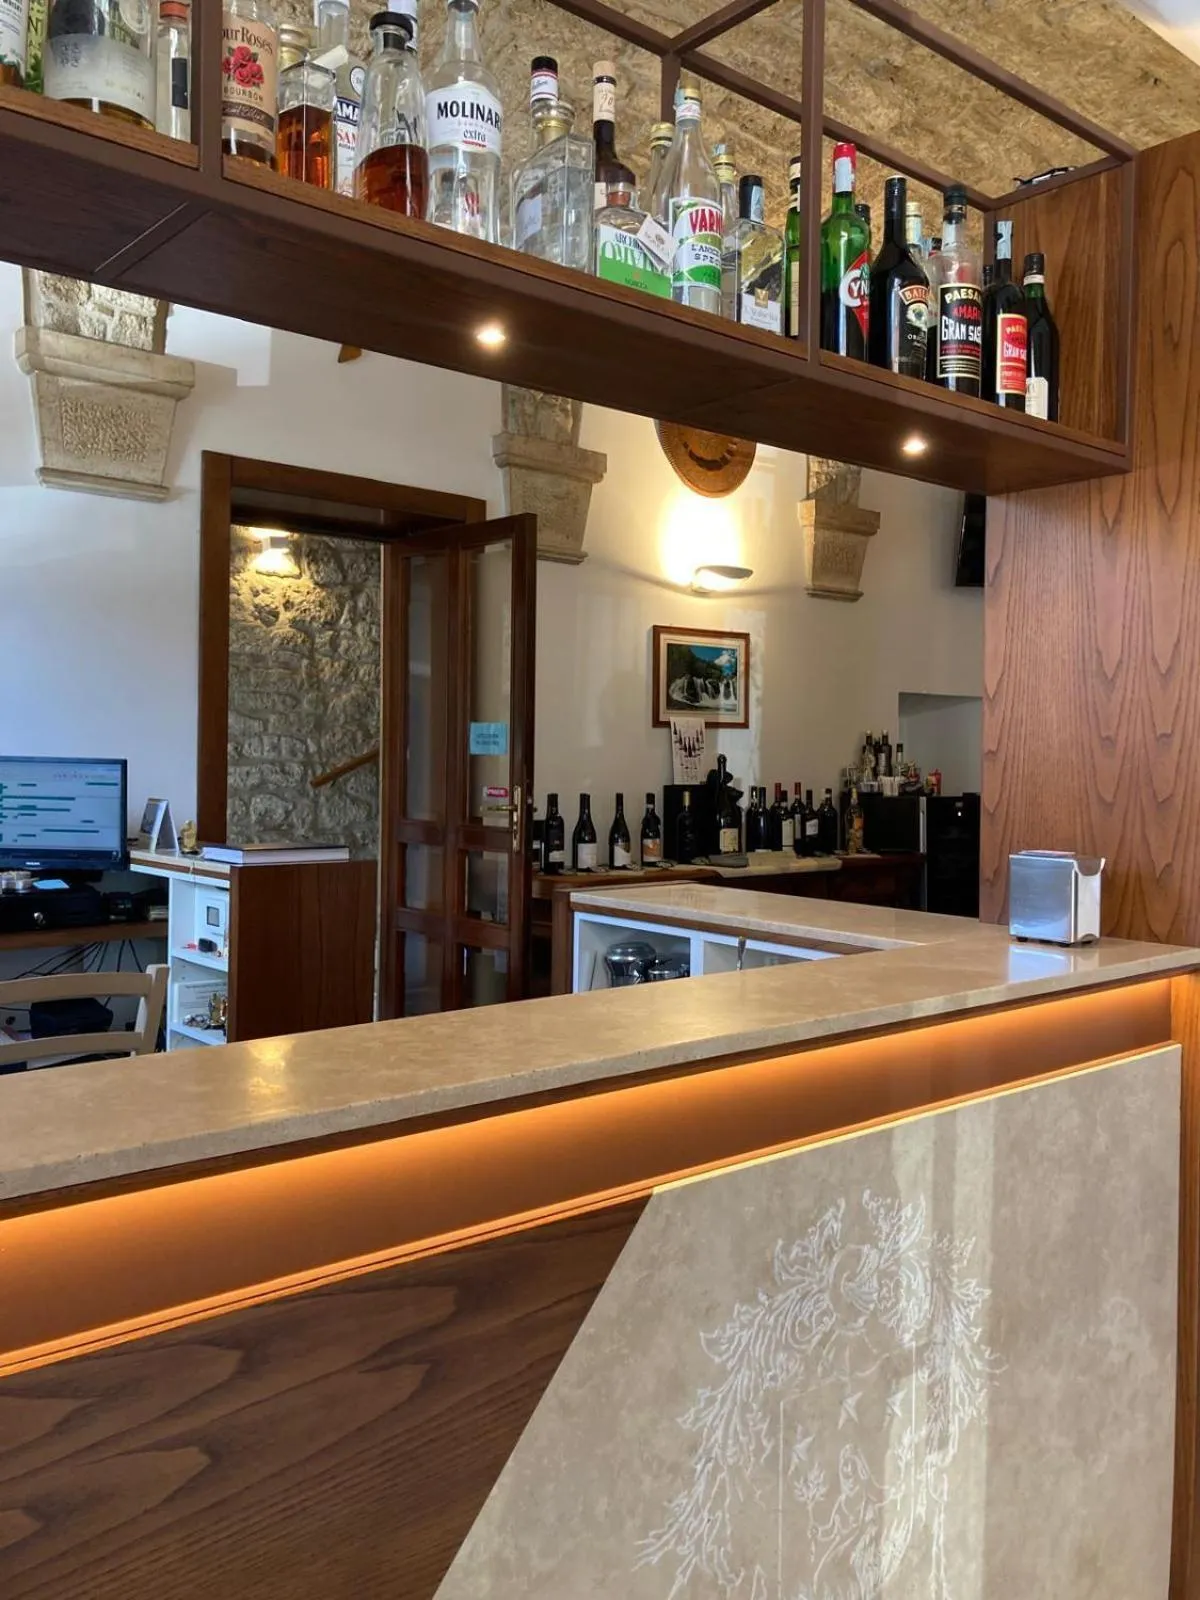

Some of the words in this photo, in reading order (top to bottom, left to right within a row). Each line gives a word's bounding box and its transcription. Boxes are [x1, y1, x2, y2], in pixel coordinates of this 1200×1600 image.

[241, 26, 273, 56] Roses
[223, 86, 264, 102] BOURBON
[463, 128, 486, 142] extra
[689, 208, 724, 235] VARN
[839, 268, 869, 308] CYN
[941, 315, 967, 341] GRAN
